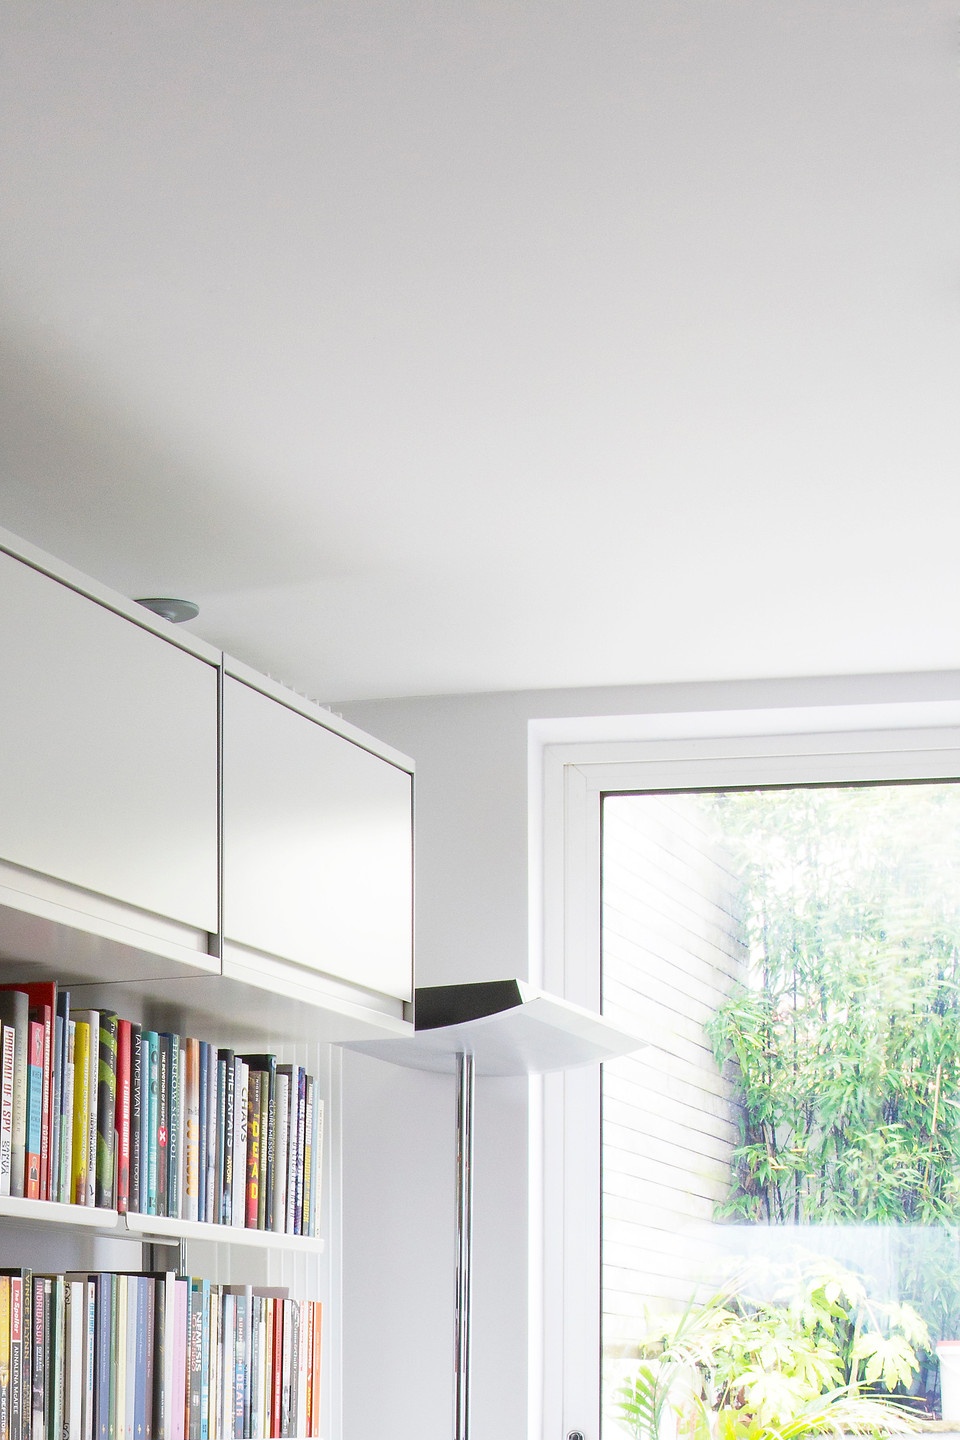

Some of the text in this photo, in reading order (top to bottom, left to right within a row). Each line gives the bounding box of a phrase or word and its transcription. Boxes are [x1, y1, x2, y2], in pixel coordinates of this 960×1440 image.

[4, 1031, 13, 1080] PORTRAIT
[4, 1084, 12, 1097] OF
[3, 1110, 11, 1132] SPY
